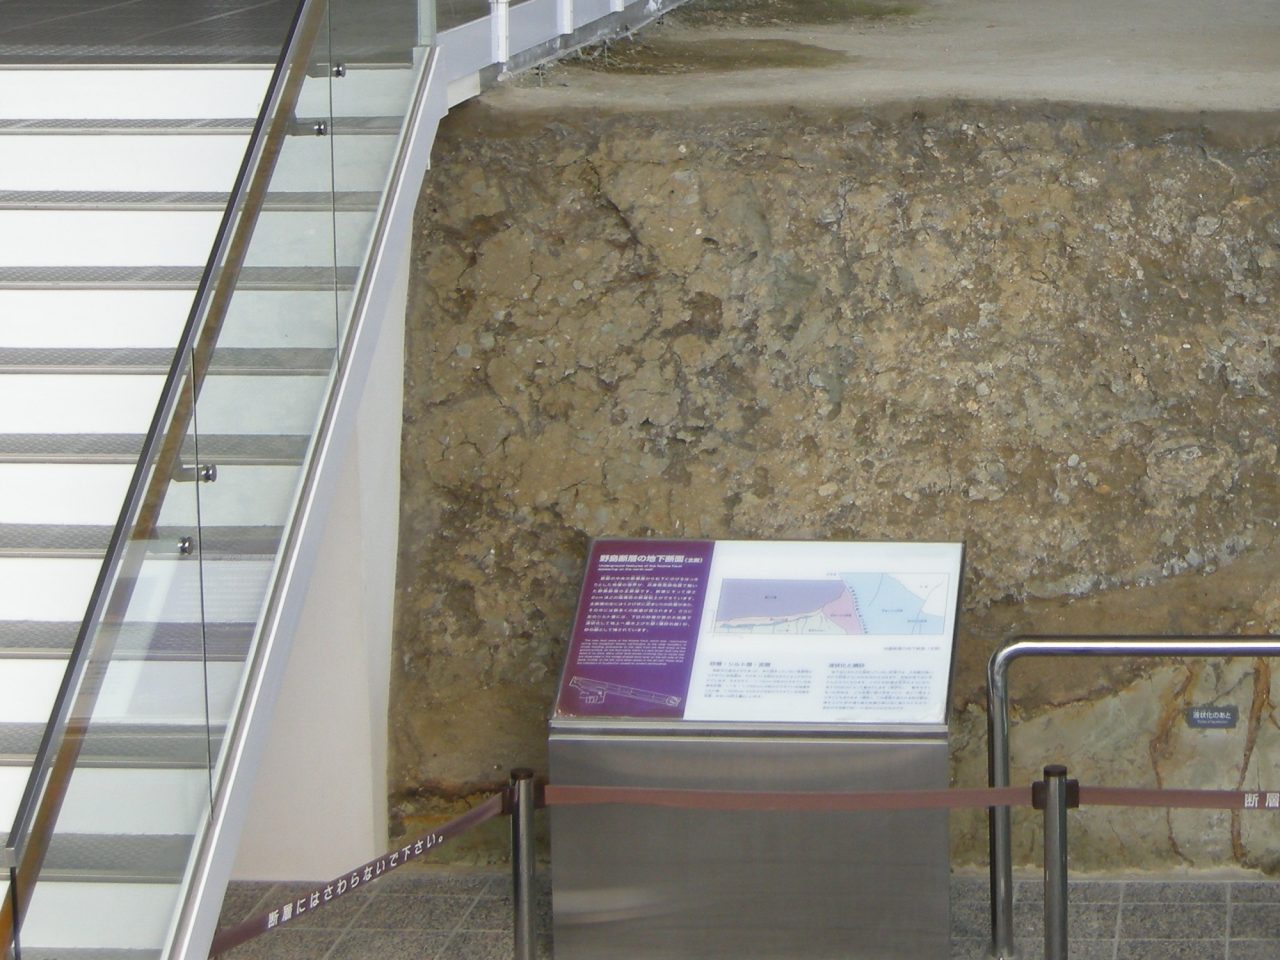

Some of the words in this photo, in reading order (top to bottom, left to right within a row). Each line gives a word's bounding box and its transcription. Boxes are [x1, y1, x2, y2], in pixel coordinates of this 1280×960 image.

[1193, 711, 1232, 719] 液状化のあと
[267, 833, 444, 928] 断層にはさわらないで下さい。
